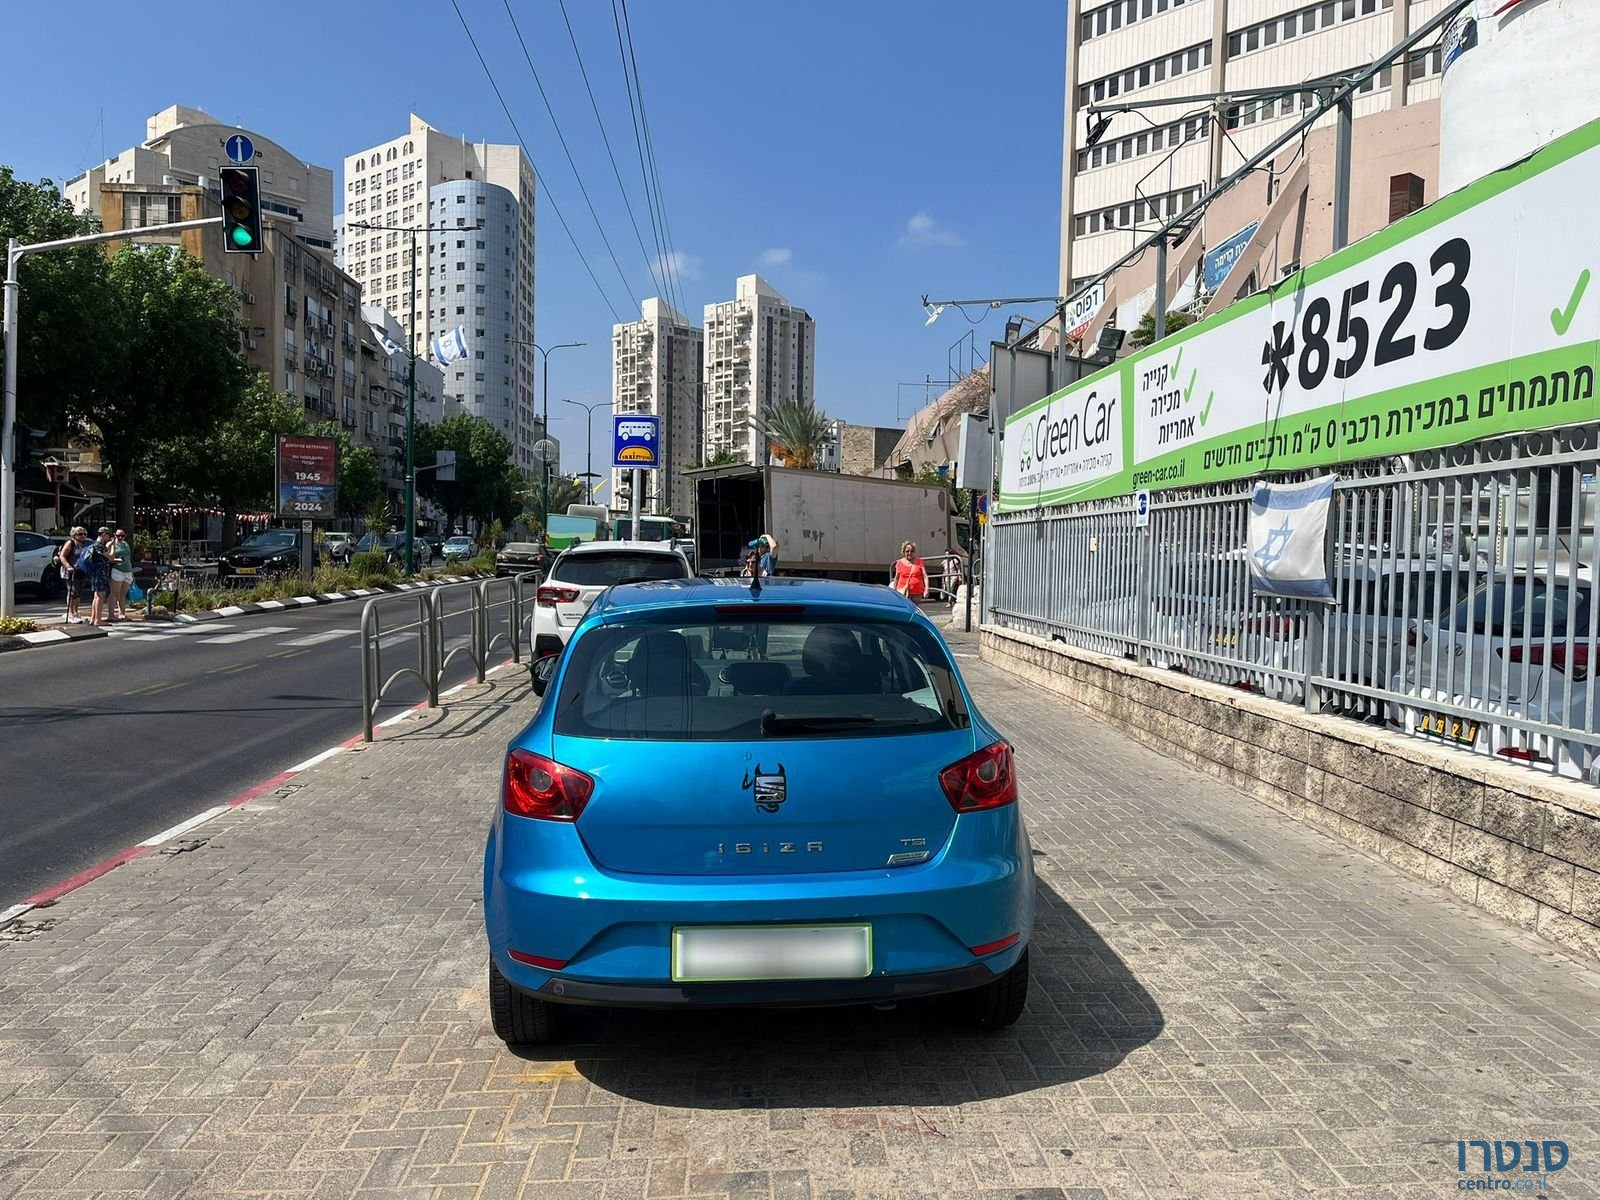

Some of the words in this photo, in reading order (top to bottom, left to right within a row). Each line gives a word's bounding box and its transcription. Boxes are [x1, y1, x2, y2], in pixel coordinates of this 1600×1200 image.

[1075, 289, 1099, 318] דפוס
[1142, 363, 1169, 392] קנייה
[1477, 365, 1594, 419] מתמחים
[1150, 389, 1181, 418] מכירה
[1385, 394, 1470, 438] במכירת
[1035, 413, 1079, 463] Green
[1083, 391, 1116, 447] Car
[1158, 415, 1196, 445] אחריות
[1326, 419, 1337, 449] 0
[1341, 414, 1380, 445] רכבי
[1203, 444, 1241, 470] חדשים
[1245, 433, 1288, 463] ורכבים
[295, 472, 321, 481] 1945
[1132, 458, 1186, 489] green-car.co.il
[294, 502, 322, 511] 2024
